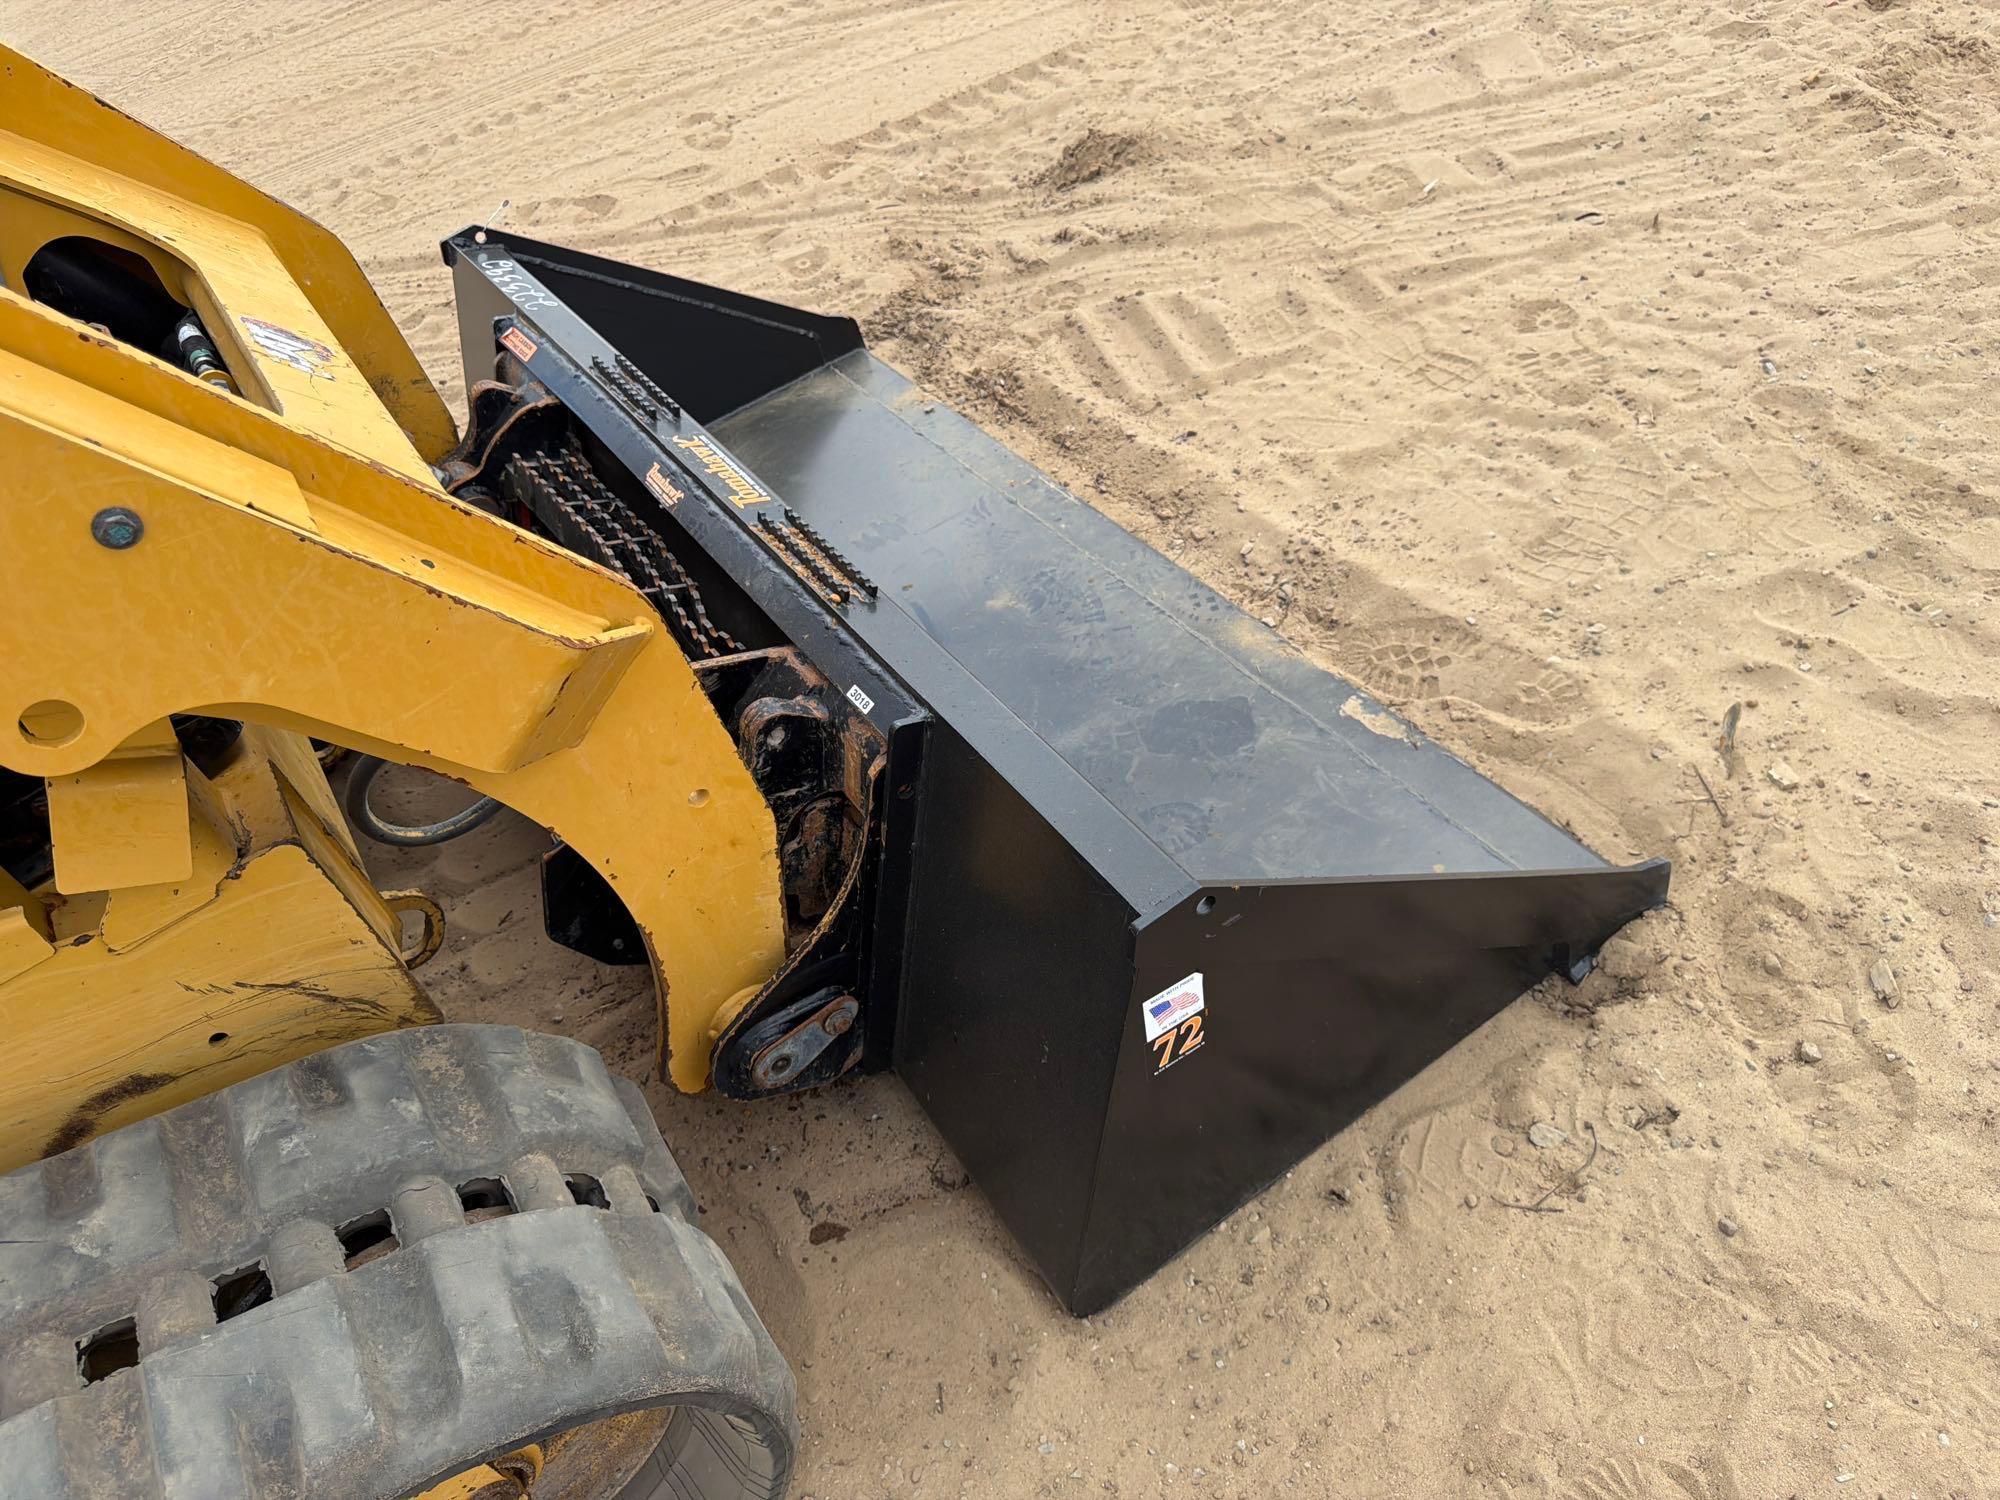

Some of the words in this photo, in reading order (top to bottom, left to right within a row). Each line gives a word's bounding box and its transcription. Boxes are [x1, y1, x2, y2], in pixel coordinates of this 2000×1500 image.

[850, 688, 870, 710] 3018
[1150, 994, 1165, 1005] MADE
[1166, 985, 1179, 996] WITH
[1180, 976, 1195, 988] PRIDE
